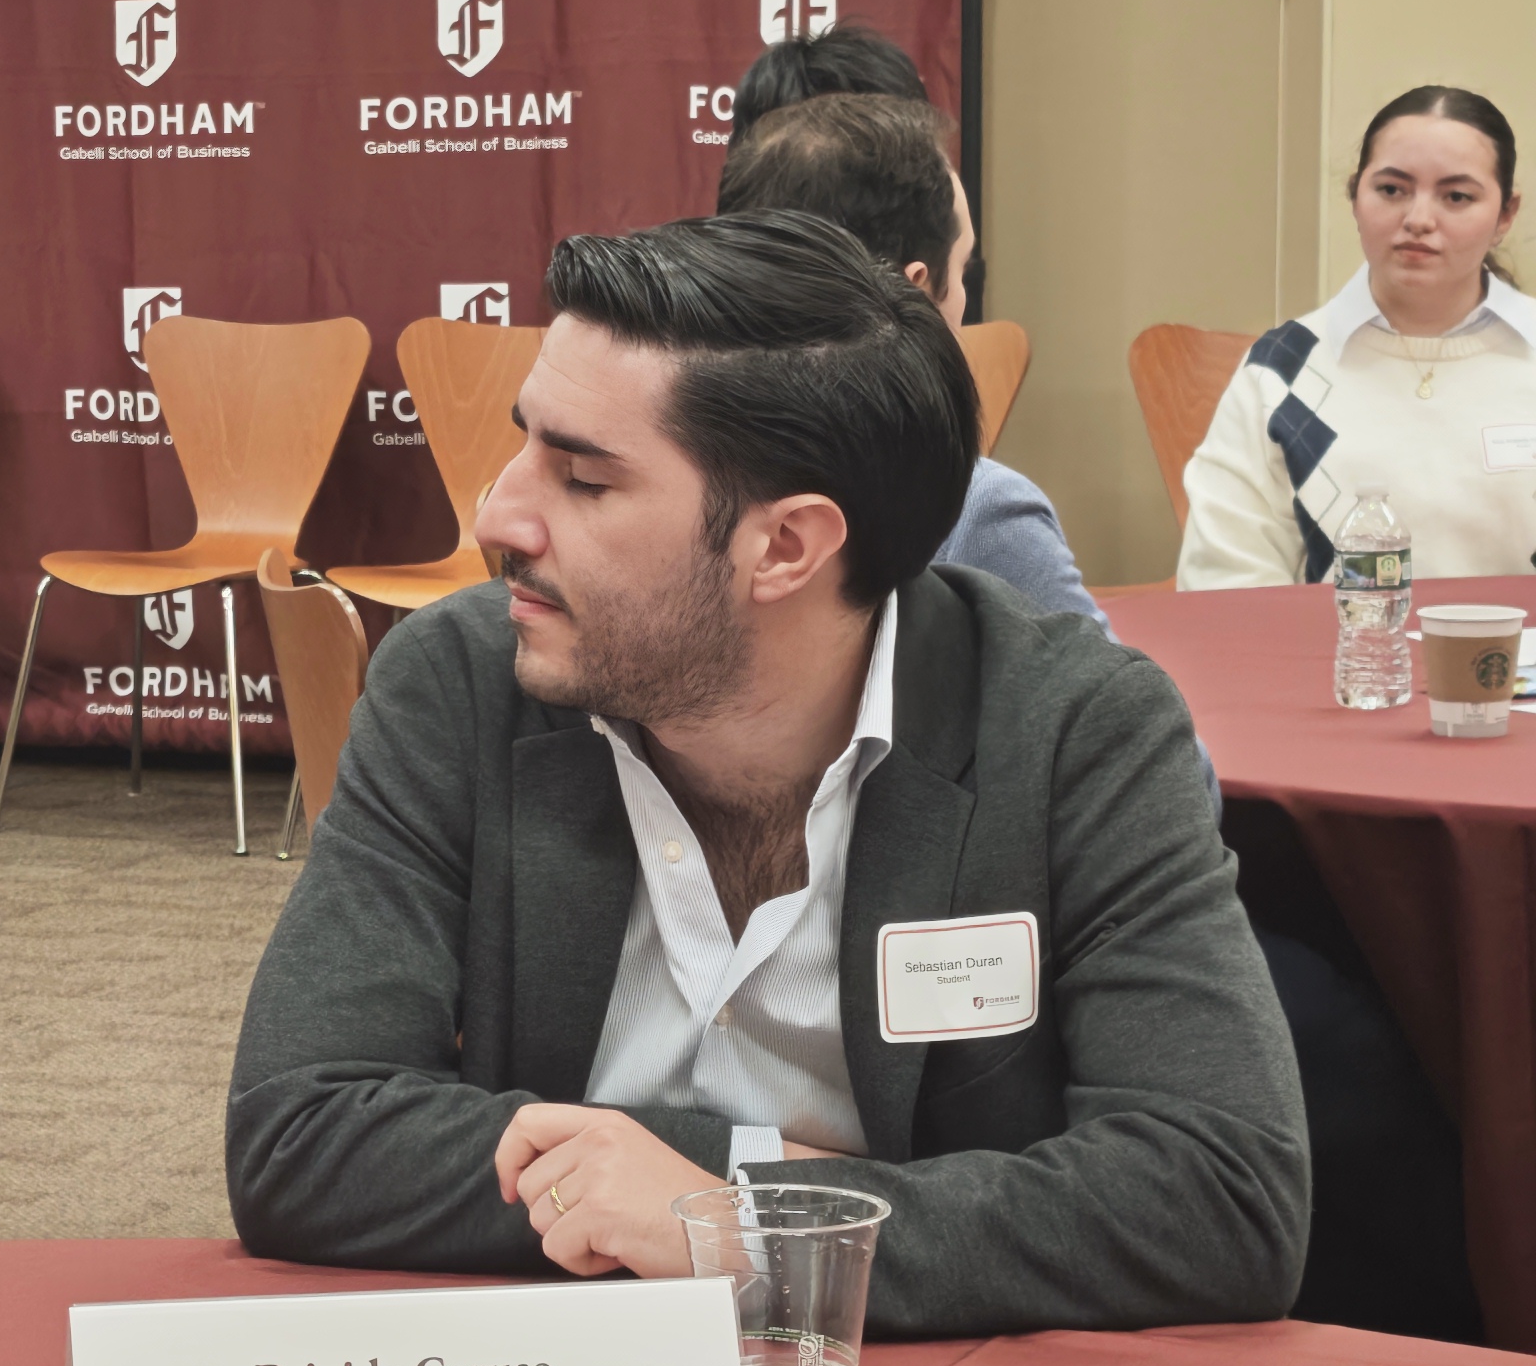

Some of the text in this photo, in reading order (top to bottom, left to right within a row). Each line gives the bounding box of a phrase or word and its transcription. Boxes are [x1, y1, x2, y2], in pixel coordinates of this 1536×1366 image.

[55, 102, 253, 137] FORDHAM
[360, 92, 572, 131] FORDHAM
[60, 143, 251, 161] Gabelli School of Business
[364, 135, 569, 155] Gabelli School of Business
[65, 389, 161, 422] FORD
[71, 429, 160, 446] Gabelli School
[372, 432, 426, 446] Gabelli
[905, 956, 1003, 973] Sebastian Duran
[937, 974, 971, 984] Student
